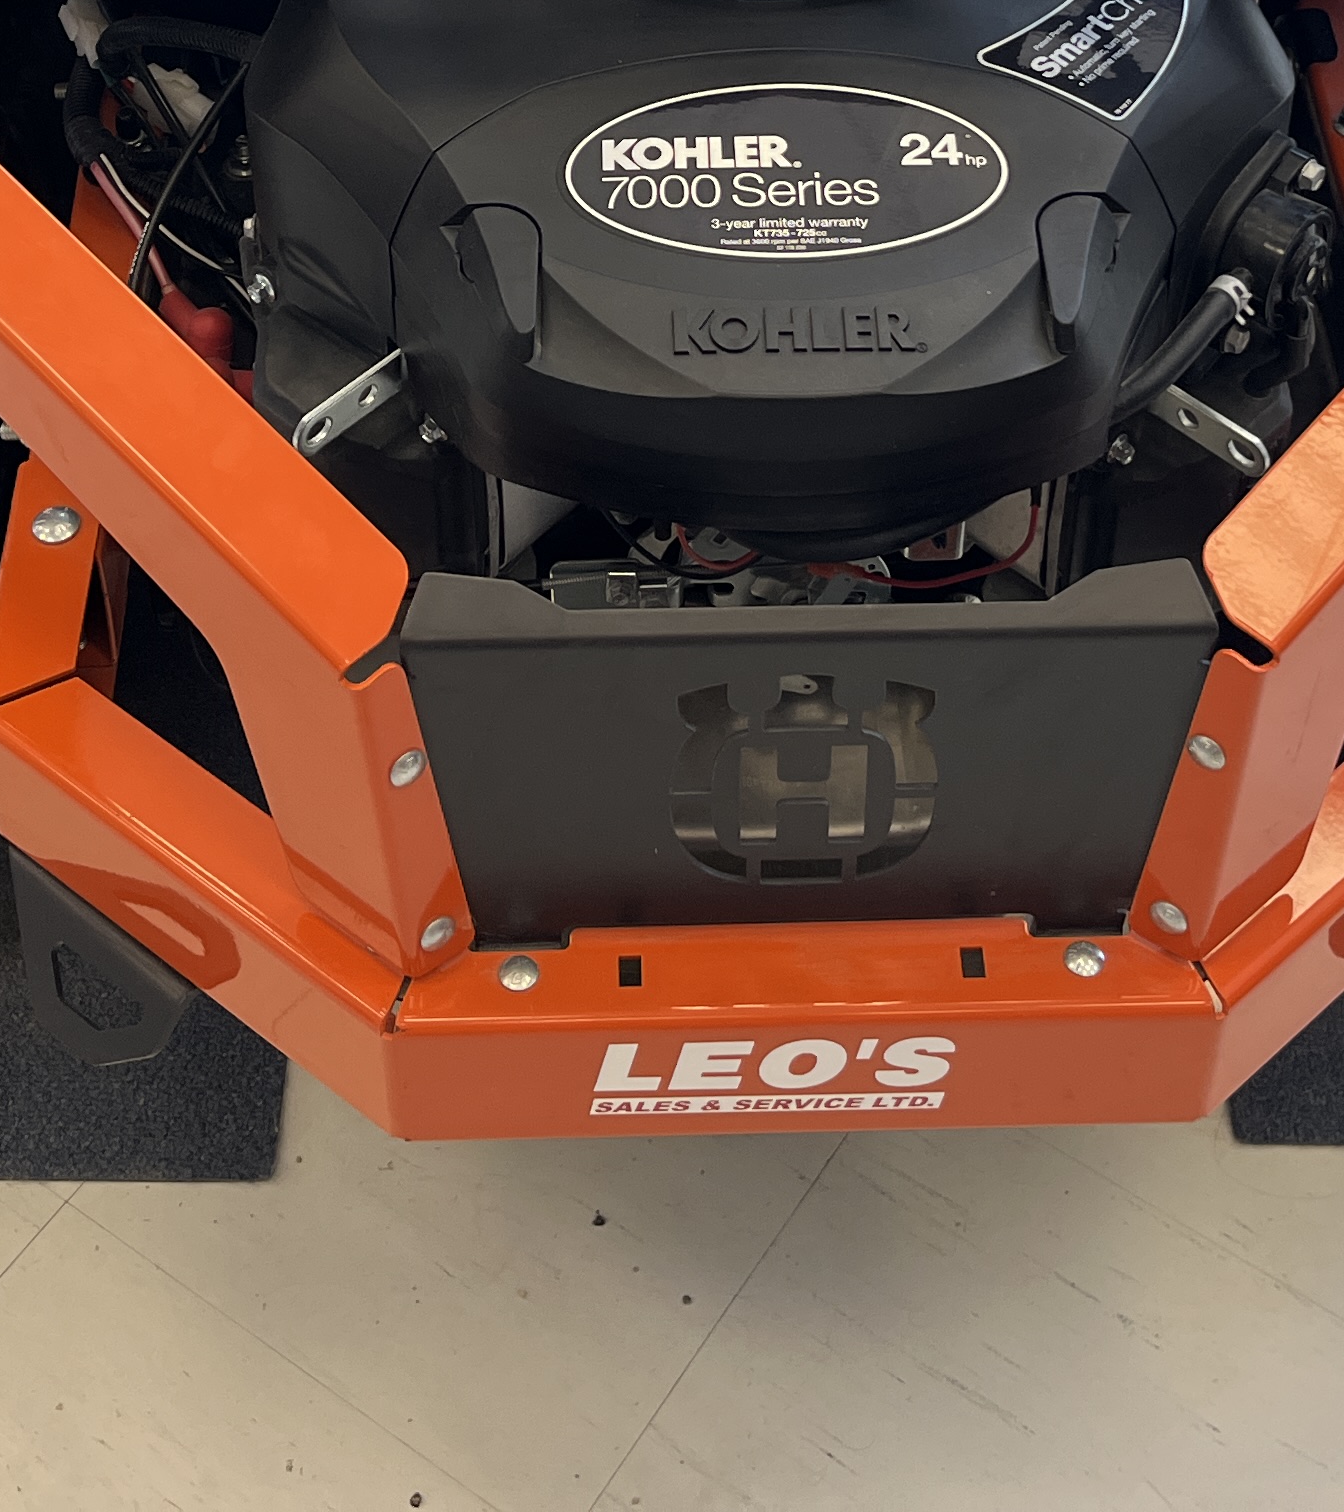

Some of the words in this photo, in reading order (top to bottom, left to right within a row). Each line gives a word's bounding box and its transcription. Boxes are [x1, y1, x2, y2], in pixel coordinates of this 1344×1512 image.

[1129, 9, 1156, 30] starting
[1082, 73, 1097, 84] No
[1094, 58, 1115, 76] prime
[1111, 36, 1140, 61] required
[601, 174, 721, 209] 7000
[731, 171, 880, 207] Series
[711, 218, 756, 231] 3-year
[759, 217, 805, 228] limited
[808, 217, 869, 230] warranty
[593, 1036, 956, 1092] LEO'S
[595, 1099, 692, 1113] SALES
[701, 1099, 721, 1111] &
[732, 1097, 864, 1111] SERVICE
[871, 1096, 934, 1109] LTD.
